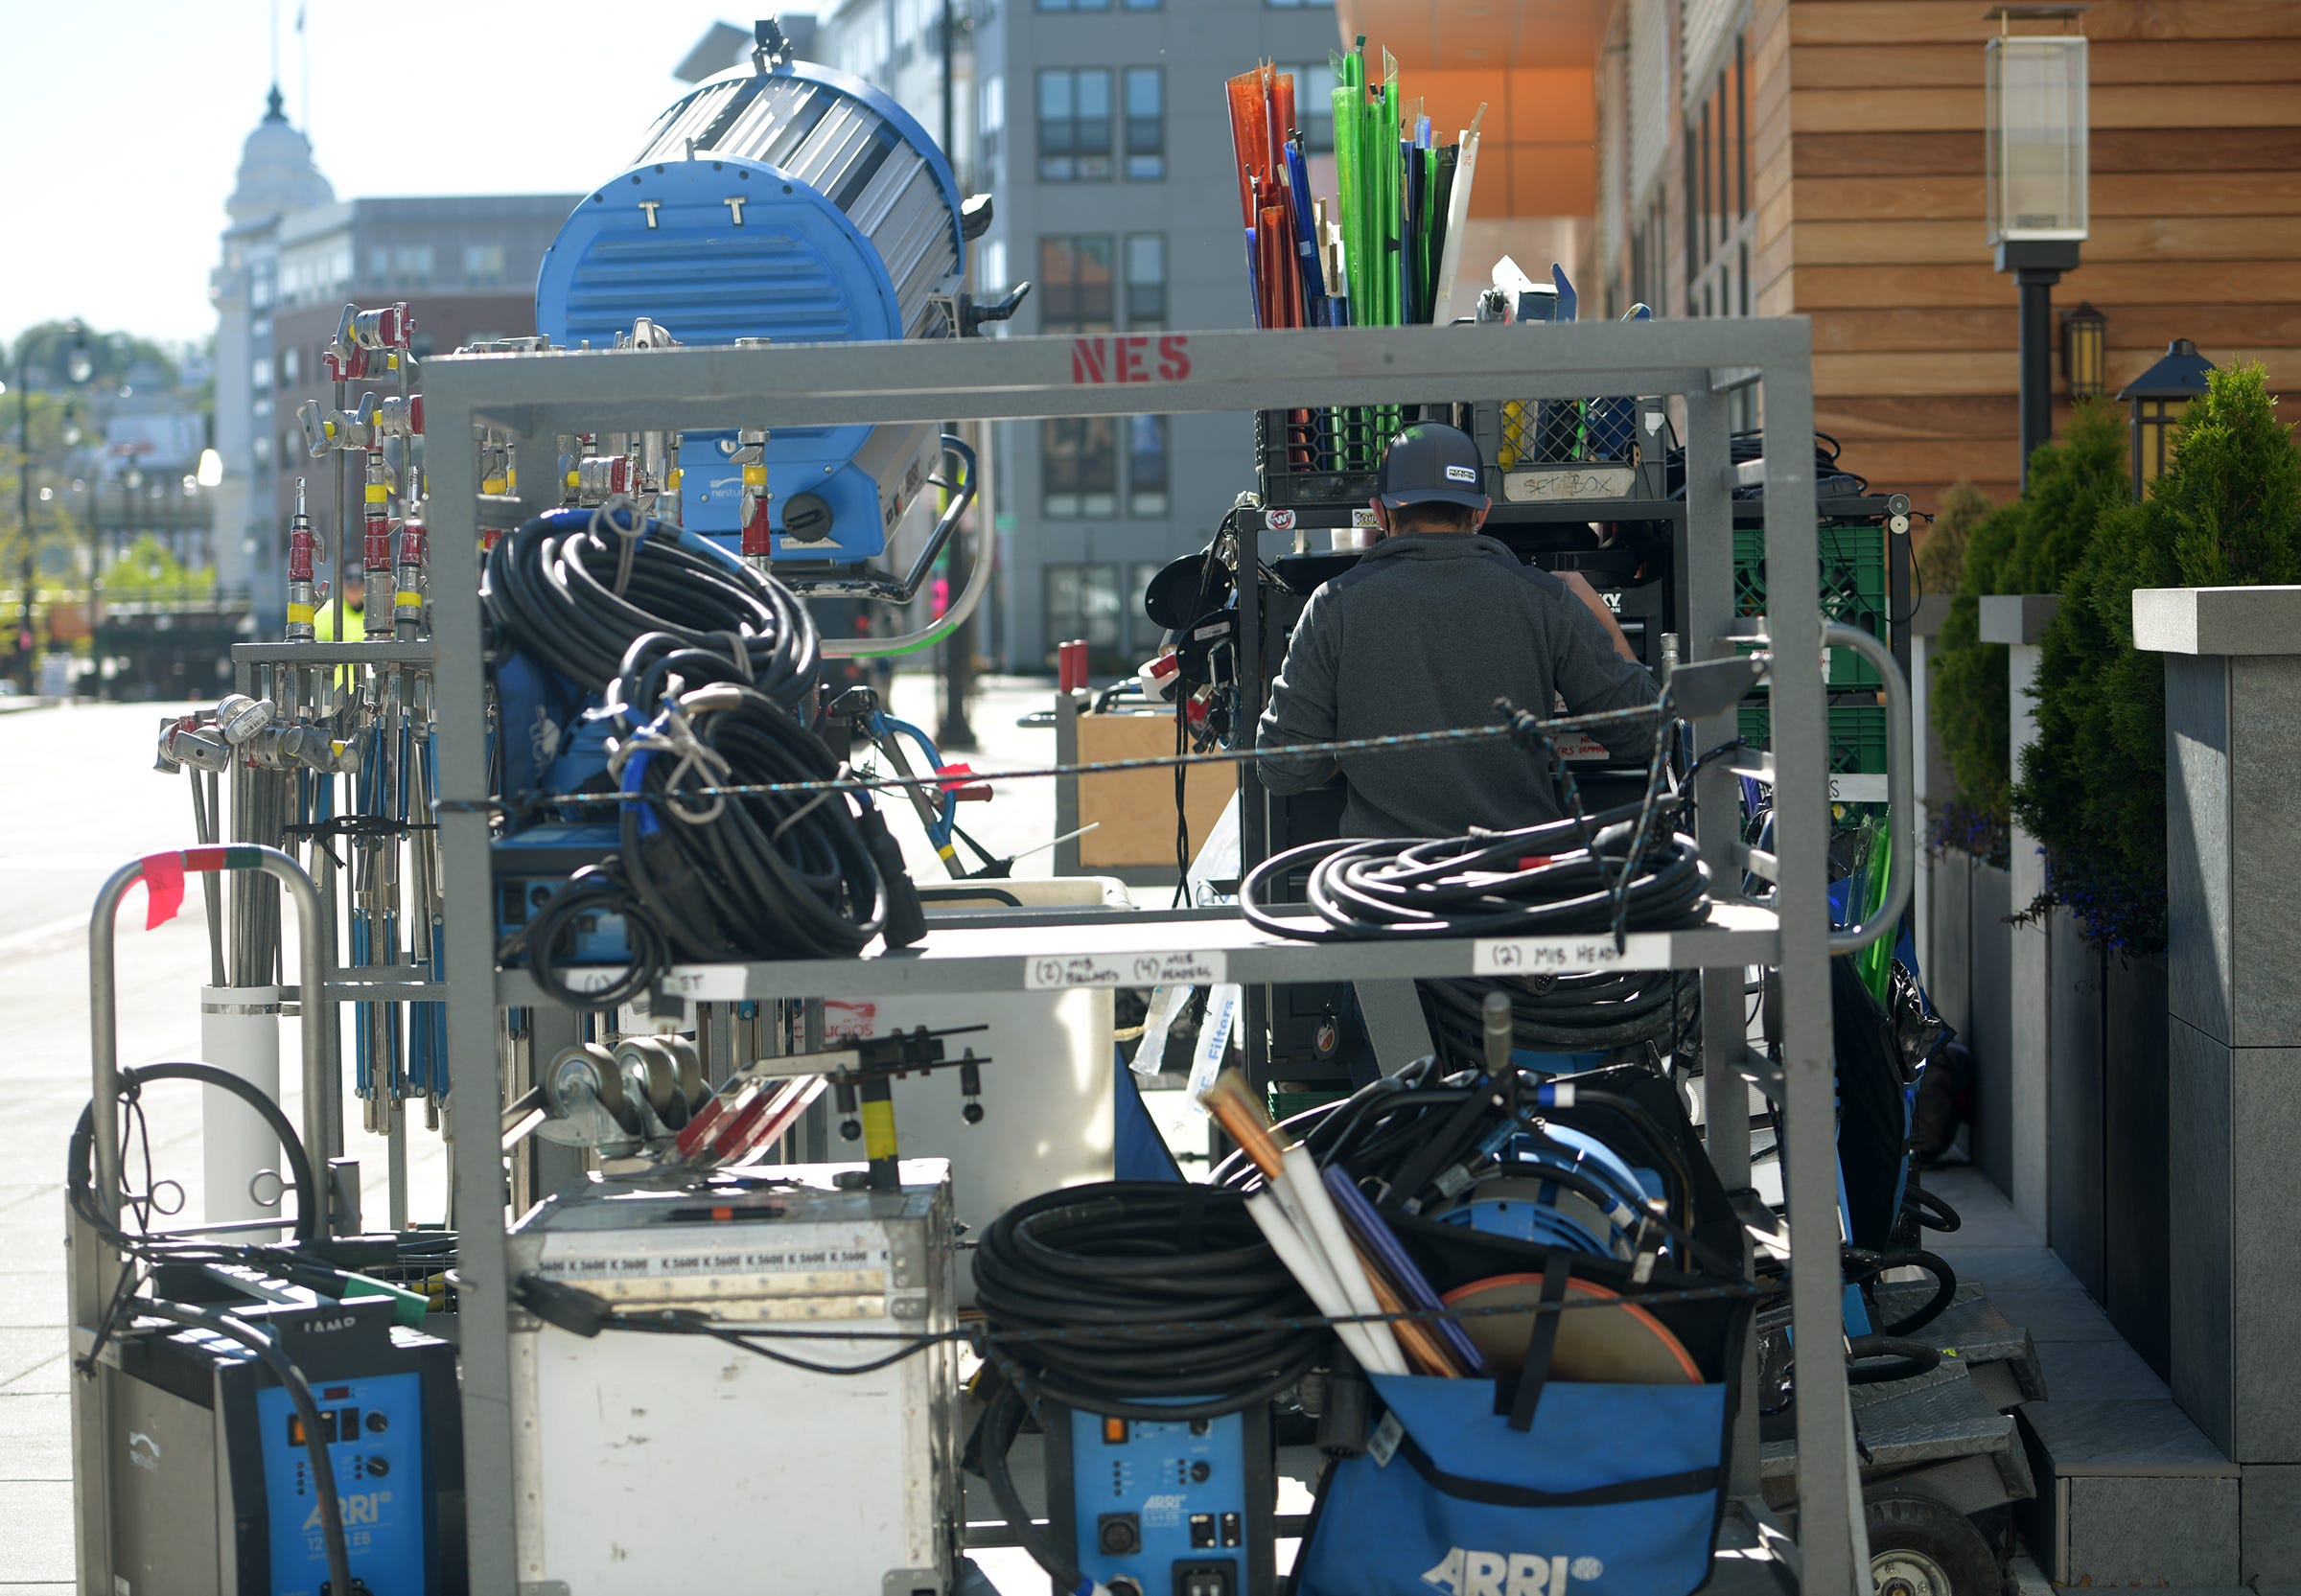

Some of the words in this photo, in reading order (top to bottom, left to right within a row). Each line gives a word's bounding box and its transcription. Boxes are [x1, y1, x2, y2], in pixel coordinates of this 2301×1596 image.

[1073, 335, 1191, 383] NES
[1523, 476, 1560, 494] SET
[1573, 474, 1613, 494] BOX
[1493, 944, 1522, 966] (2)
[1036, 960, 1062, 985] (2)
[1134, 958, 1159, 981] (4)
[1208, 1000, 1234, 1060] Filters
[1421, 1546, 1569, 1596] ARRI
